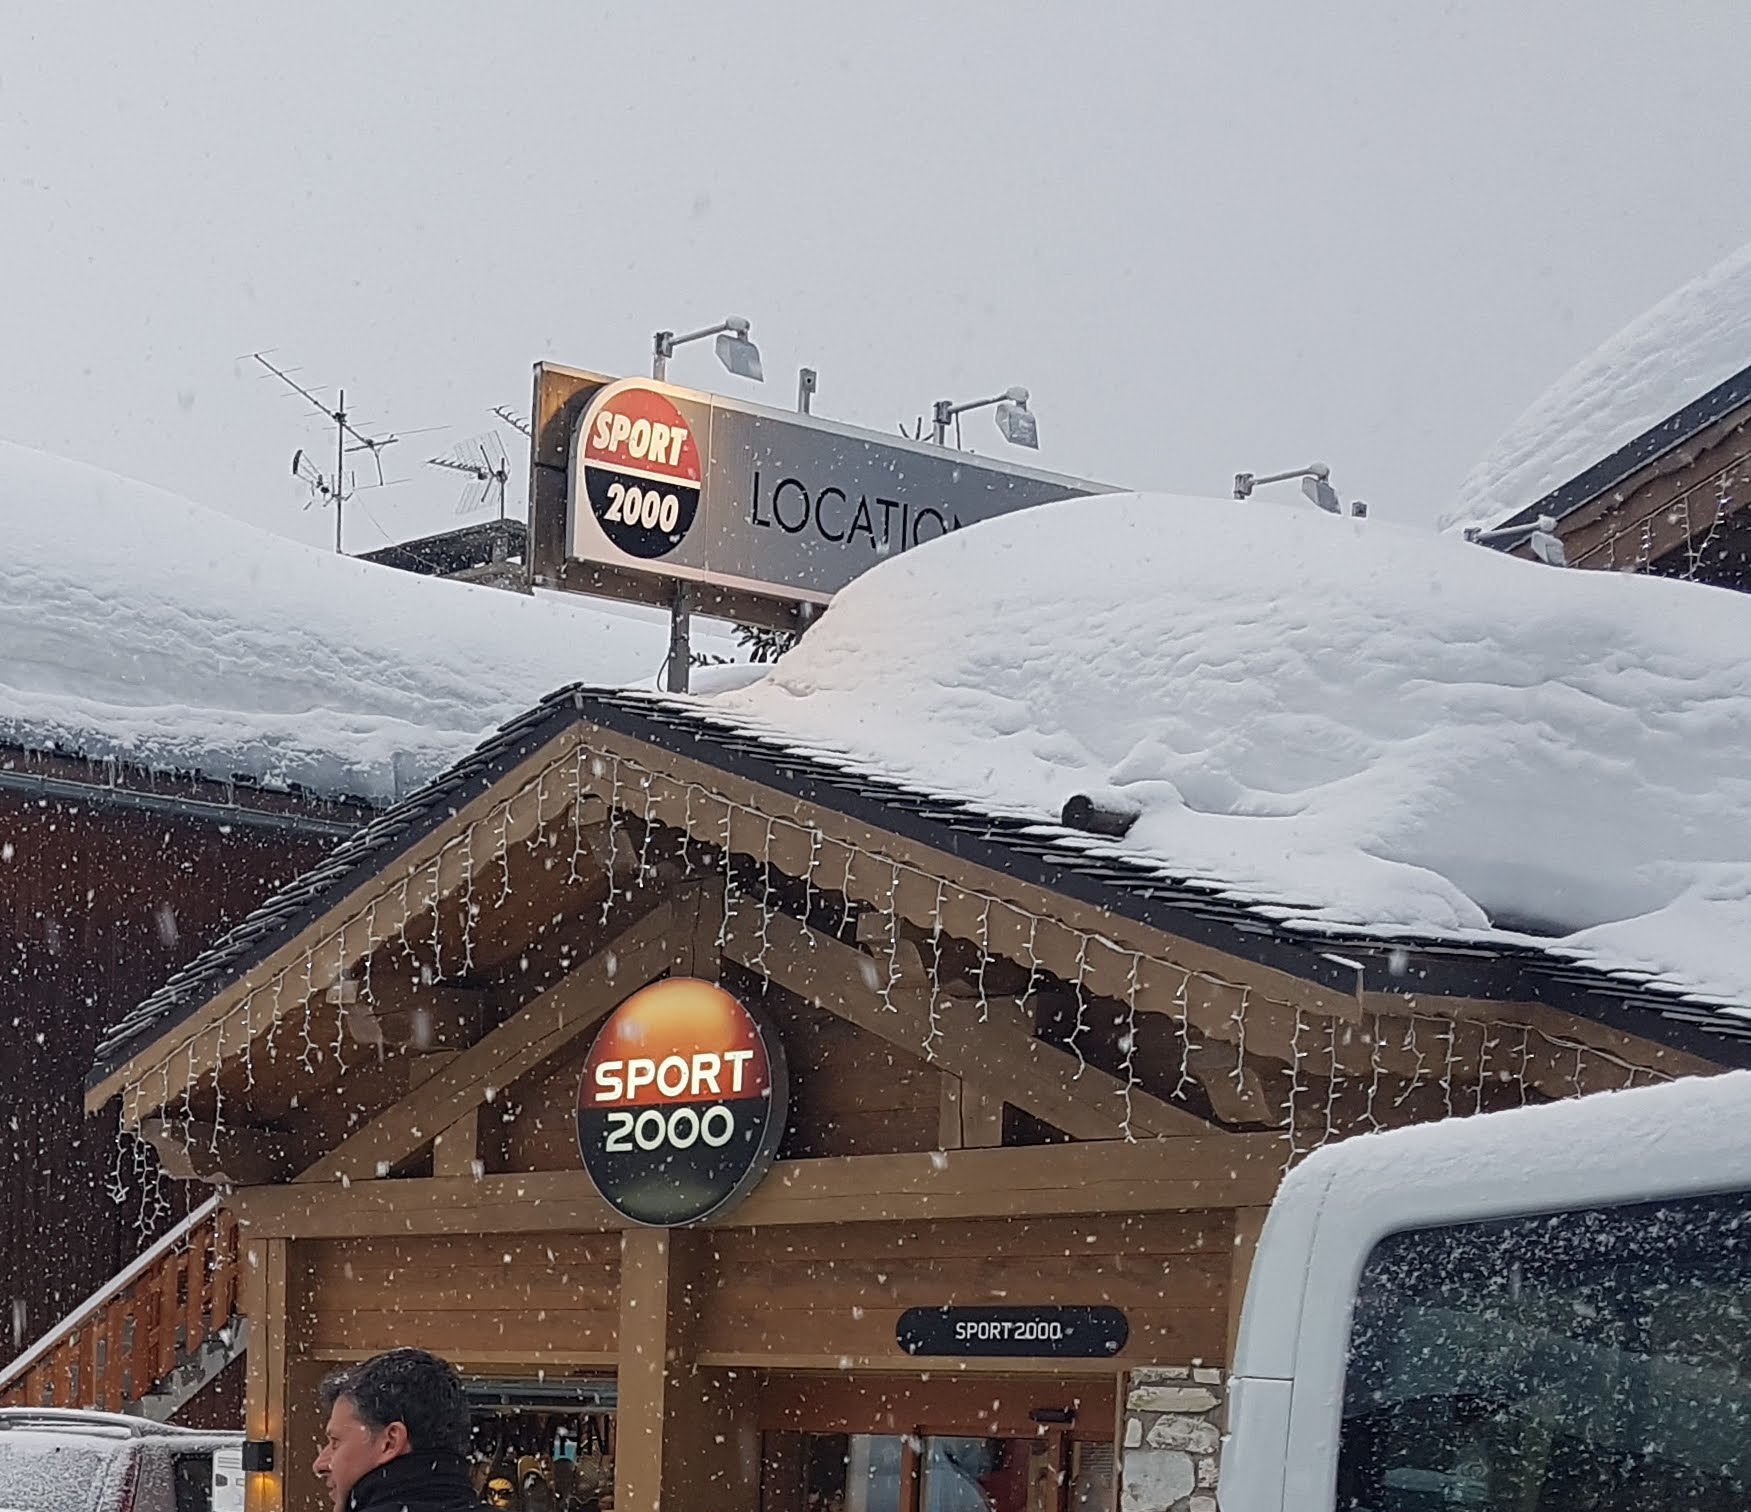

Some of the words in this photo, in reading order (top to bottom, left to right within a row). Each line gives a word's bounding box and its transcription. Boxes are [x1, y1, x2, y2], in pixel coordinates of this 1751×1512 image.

[592, 410, 689, 467] SPORT
[603, 482, 680, 534] 2000
[752, 471, 981, 553] LOCATIO
[594, 1049, 754, 1102] SPORT
[605, 1104, 735, 1153] 2000
